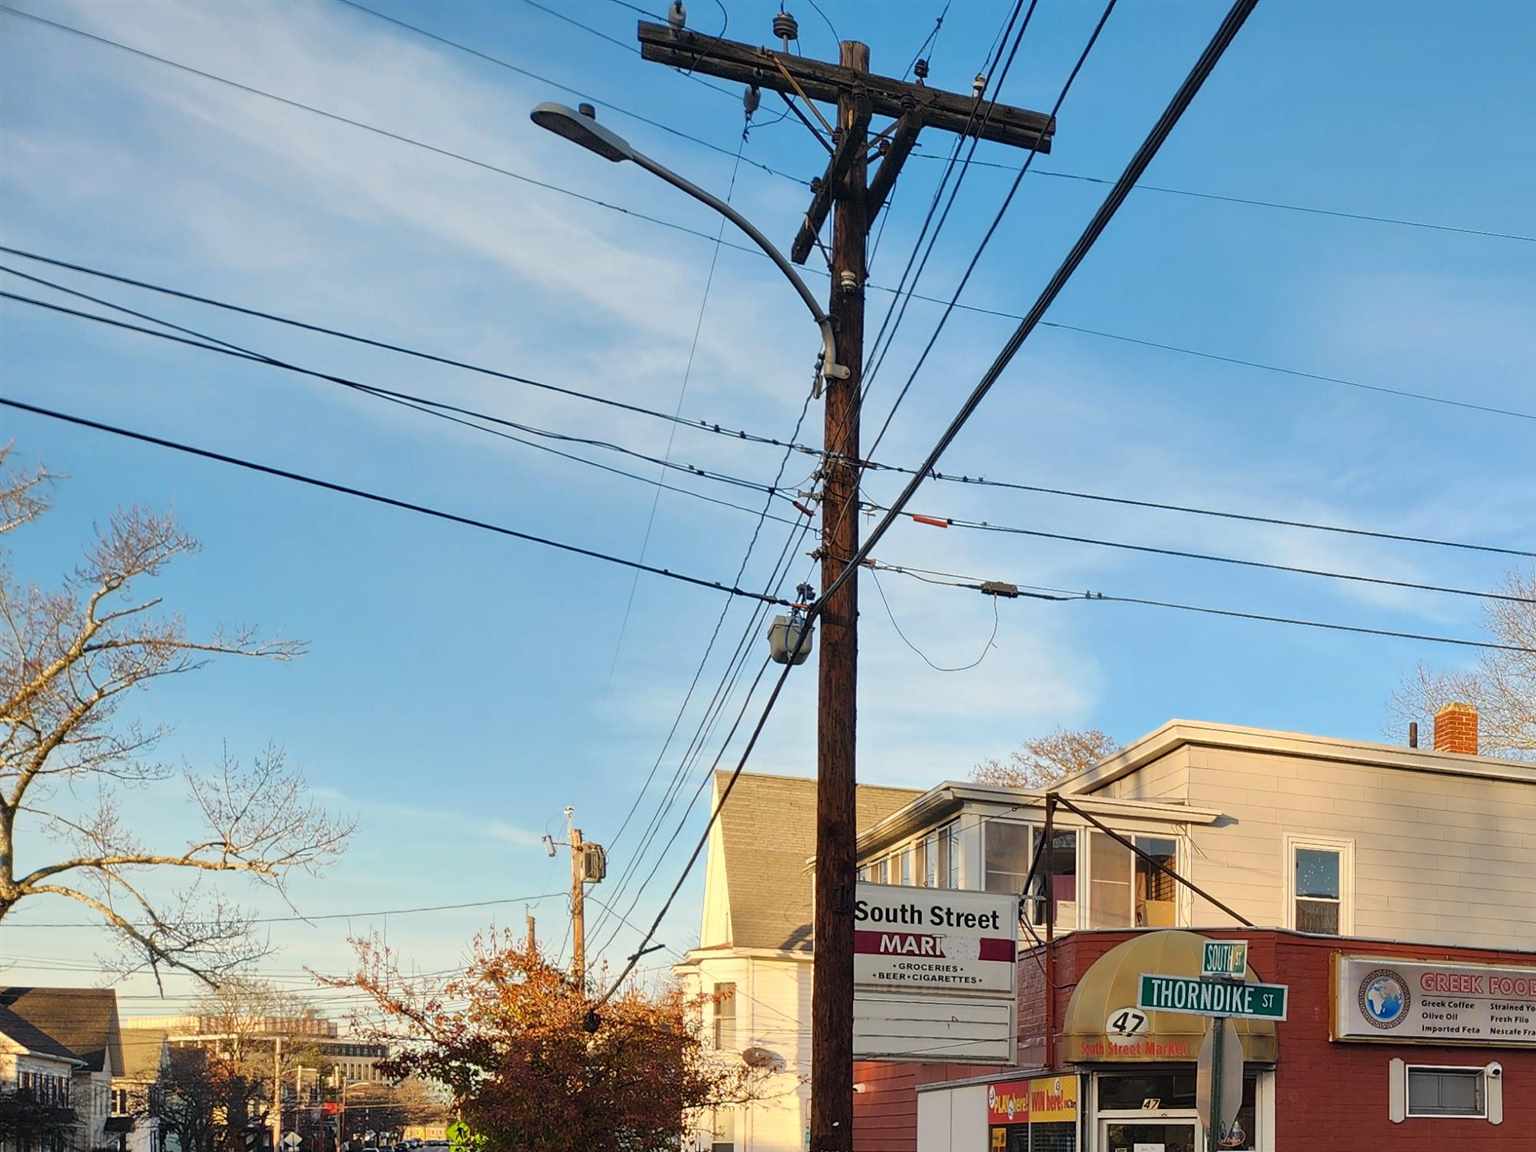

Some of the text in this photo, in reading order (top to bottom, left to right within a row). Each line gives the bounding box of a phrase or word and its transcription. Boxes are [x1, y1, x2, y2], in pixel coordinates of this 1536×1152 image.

[854, 900, 1000, 930] South Street
[879, 934, 946, 956] MART
[1206, 944, 1242, 972] SOUTH ST
[898, 963, 958, 972] GROCERIES
[1420, 972, 1484, 994] GREEK
[1151, 979, 1275, 1014] THORNDIKE ST
[1421, 999, 1475, 1009] Greek Coffee
[1490, 1003, 1524, 1012] Strained
[1421, 1012, 1458, 1020] Olive Oil
[1490, 1015, 1512, 1023] Fresh
[1112, 1011, 1145, 1038] 47
[1421, 1024, 1481, 1034] Imported Feta
[1489, 1027, 1521, 1036] Nescafe
[1081, 1040, 1189, 1057] South Street Market
[1143, 1099, 1160, 1109] 47
